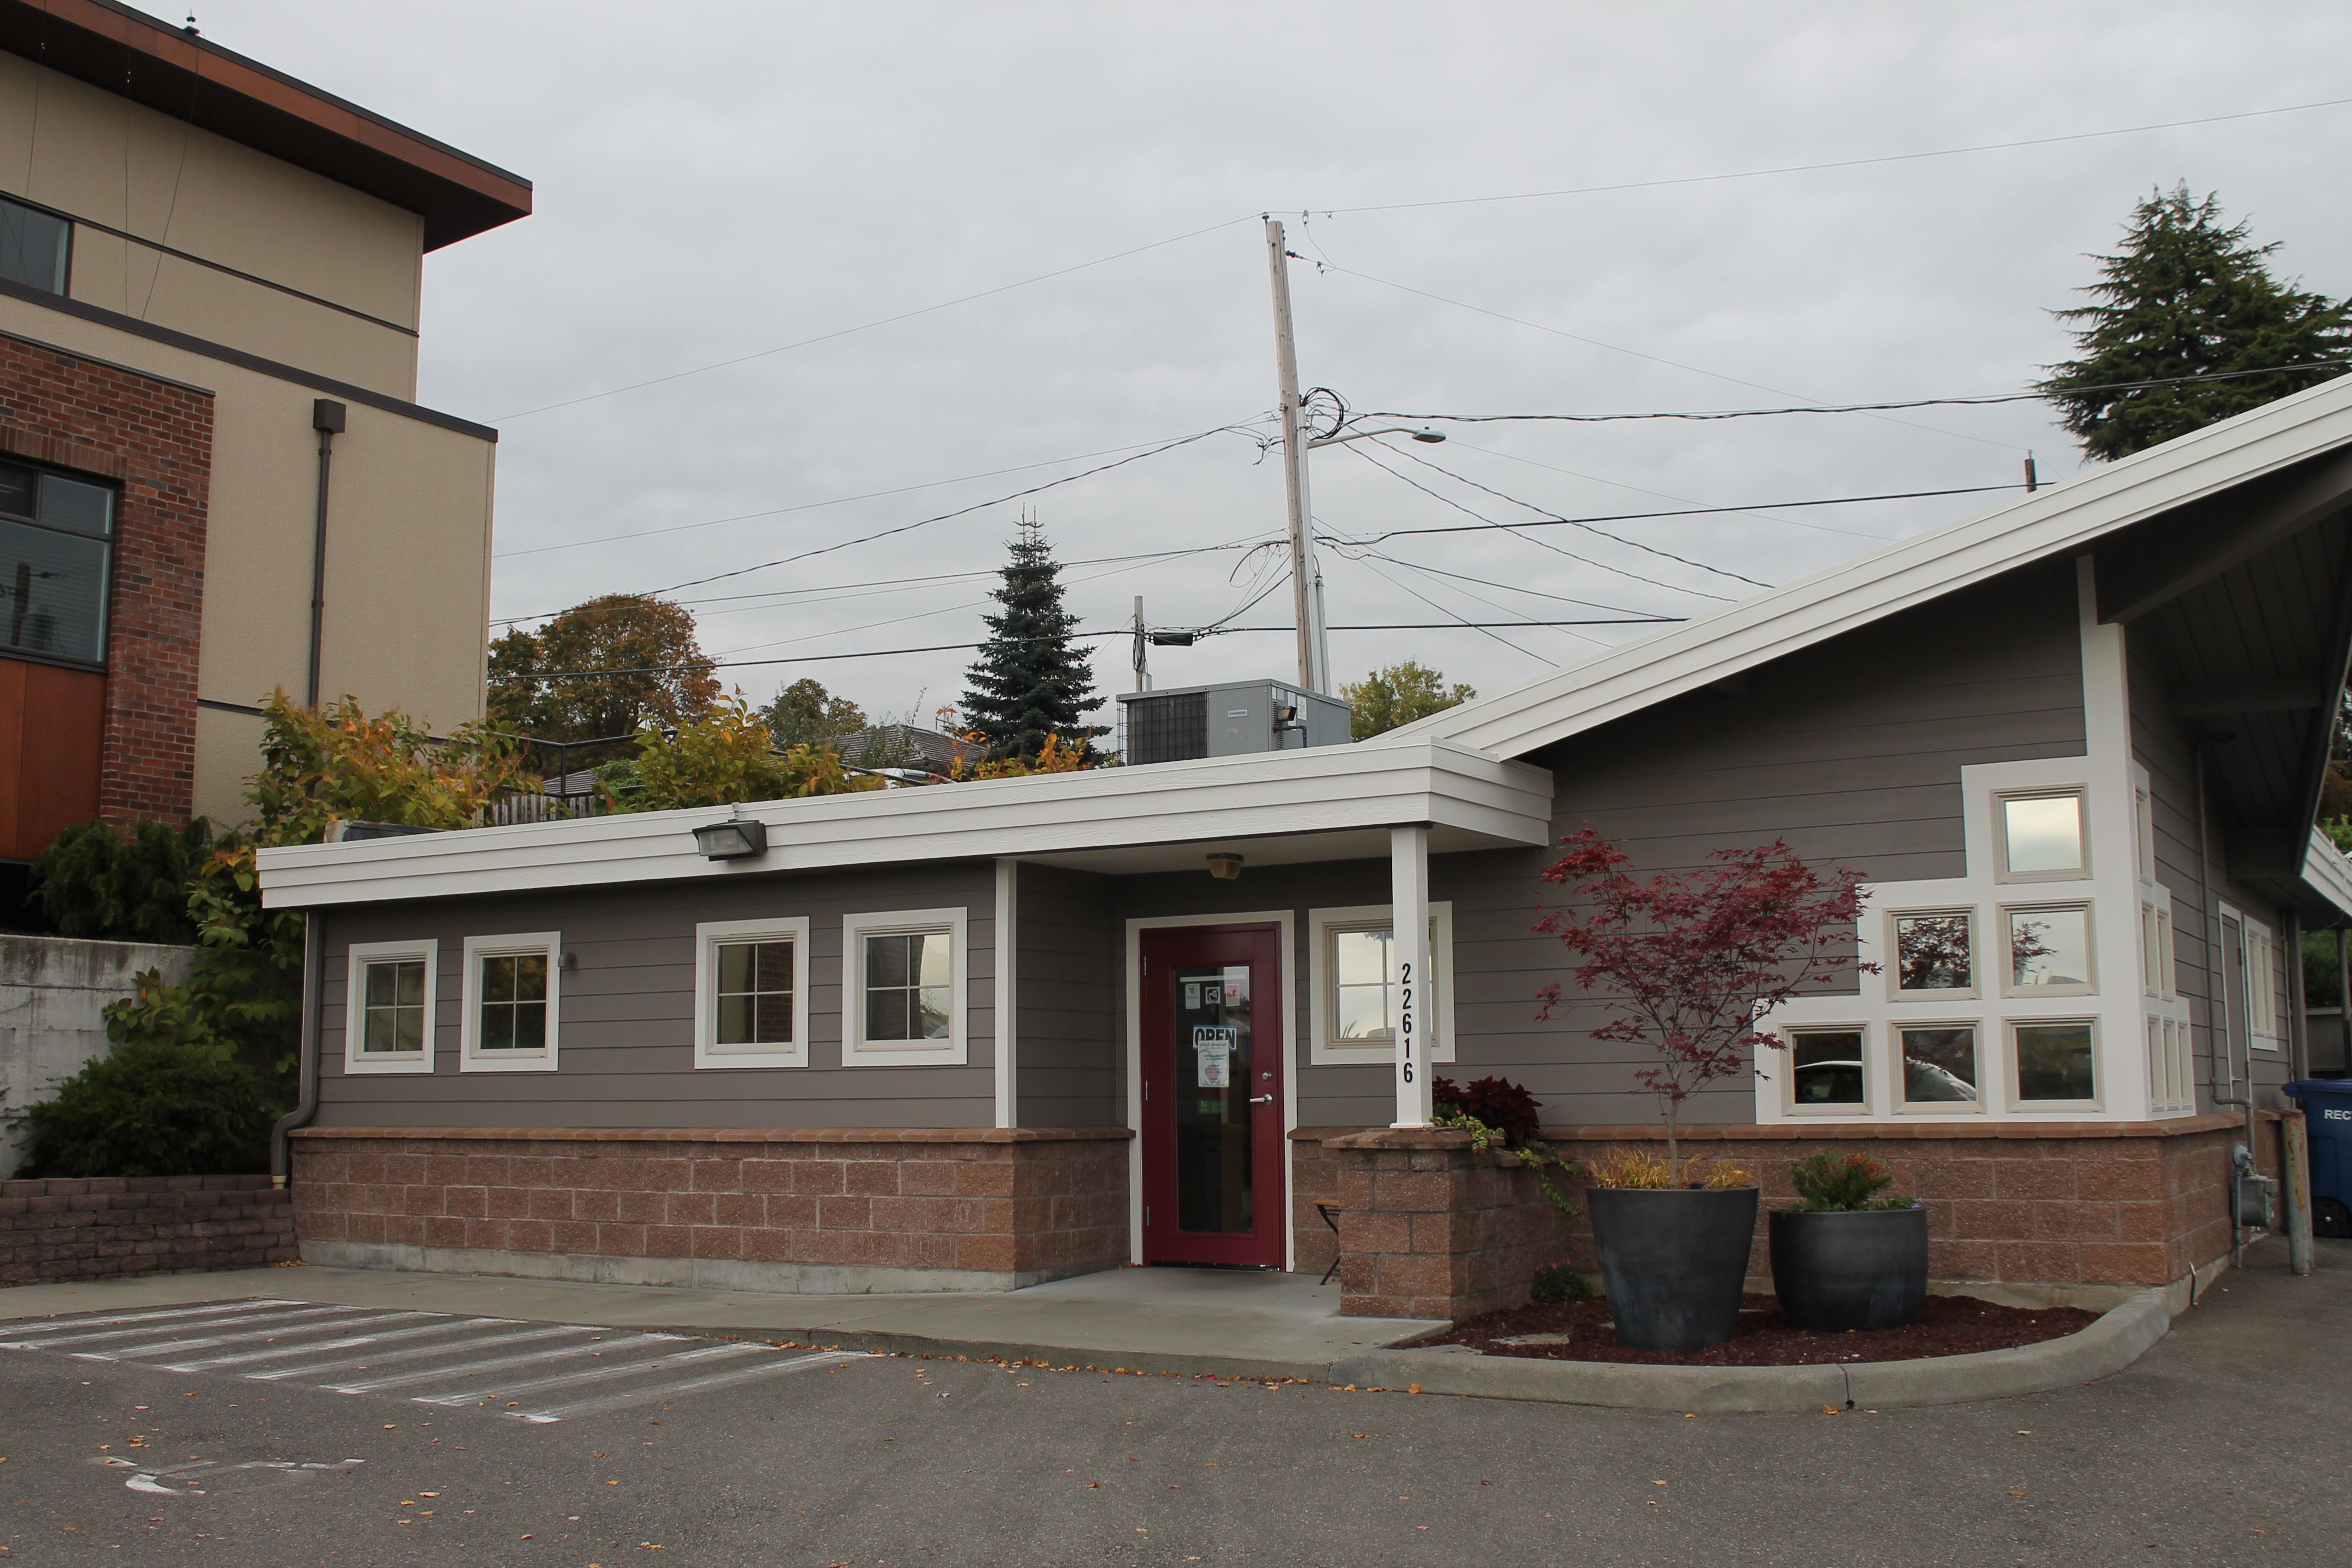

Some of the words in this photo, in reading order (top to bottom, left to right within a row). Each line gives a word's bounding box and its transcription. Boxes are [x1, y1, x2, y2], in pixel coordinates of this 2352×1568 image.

[1401, 962, 1413, 1084] 22616
[1195, 1028, 1235, 1048] OPEN
[2324, 1109, 2352, 1120] REC
